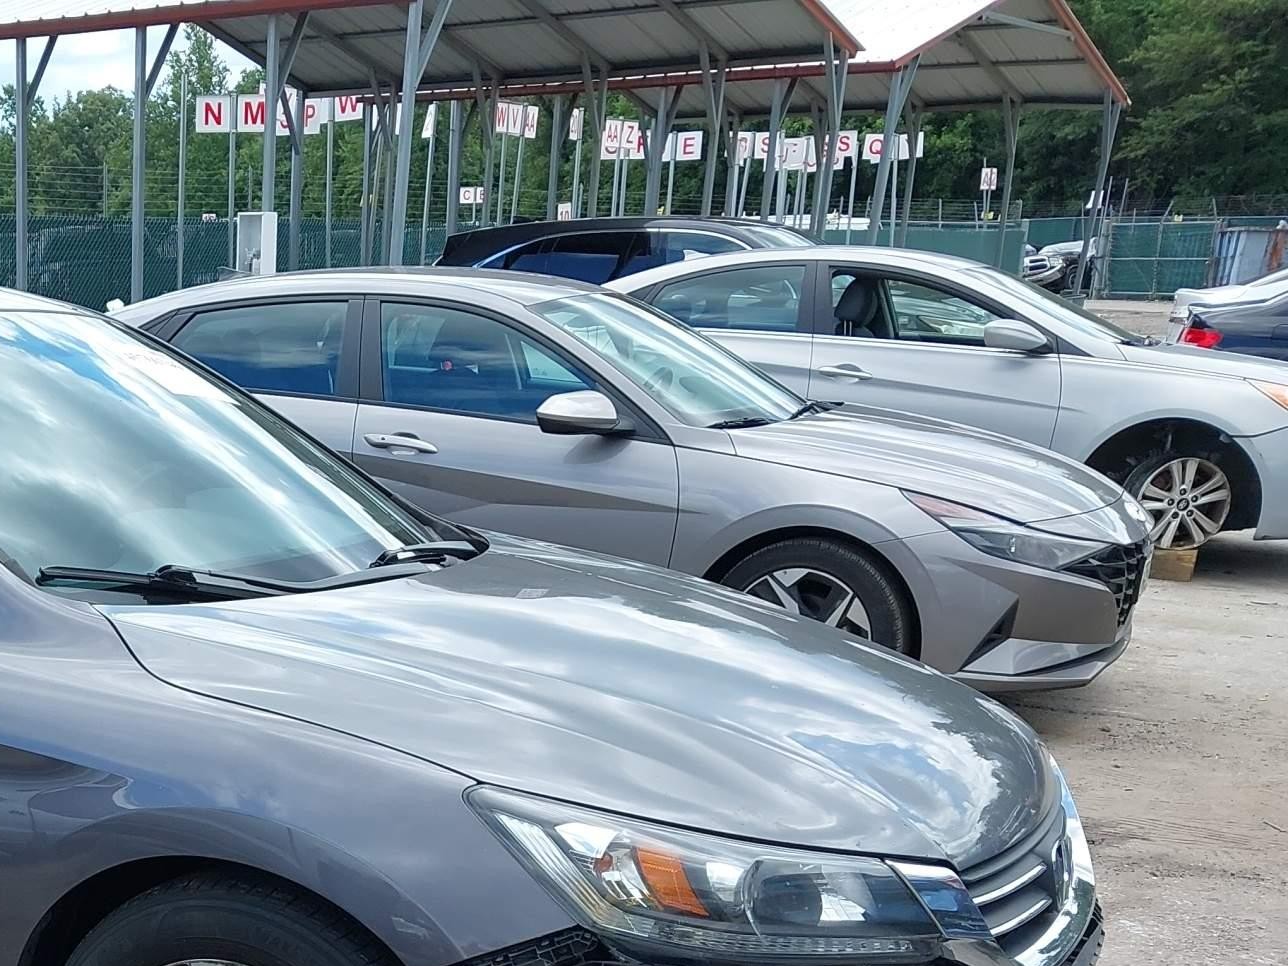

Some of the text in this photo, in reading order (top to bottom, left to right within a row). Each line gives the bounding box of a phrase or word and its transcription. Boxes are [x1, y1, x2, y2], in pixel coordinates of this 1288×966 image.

[204, 102, 222, 126] N
[244, 101, 265, 125] M
[304, 104, 316, 128] P
[626, 125, 635, 144] Z
[838, 135, 850, 152] S
[683, 136, 696, 155] E
[869, 138, 884, 155] Q
[463, 189, 471, 201] C
